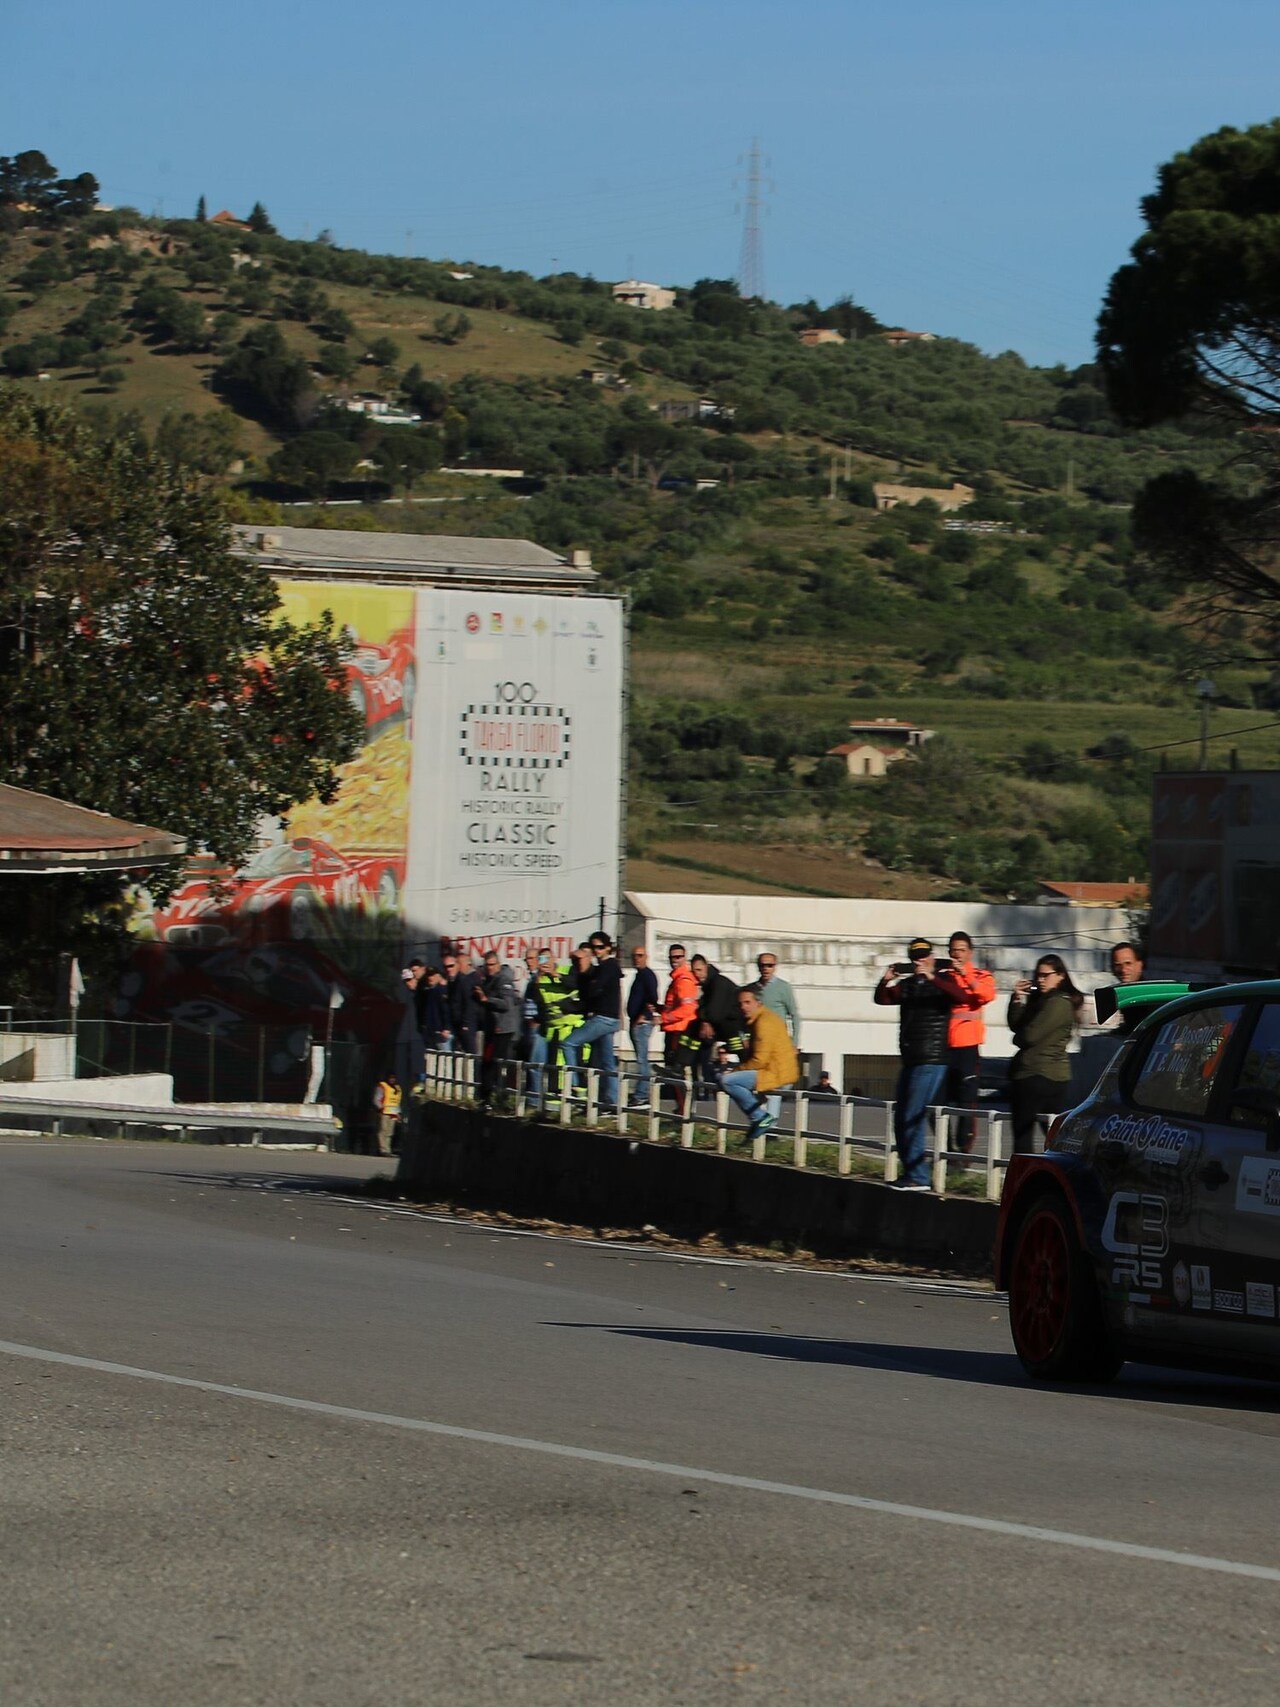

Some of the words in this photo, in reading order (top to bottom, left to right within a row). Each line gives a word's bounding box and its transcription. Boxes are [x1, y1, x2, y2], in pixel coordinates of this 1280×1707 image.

[473, 721, 512, 750] TARGA
[480, 771, 546, 792] RALLY
[461, 800, 521, 814] HISTORIC
[526, 801, 564, 815] RALLY
[466, 823, 558, 844] CLASSIC
[459, 853, 520, 867] HISTORIC
[524, 854, 563, 868] SPEED
[475, 909, 534, 924] MAGGIO
[1100, 1113, 1139, 1145] Saint
[1152, 1120, 1189, 1151] Jane
[1101, 1191, 1169, 1257] C3
[1112, 1258, 1162, 1288] R5
